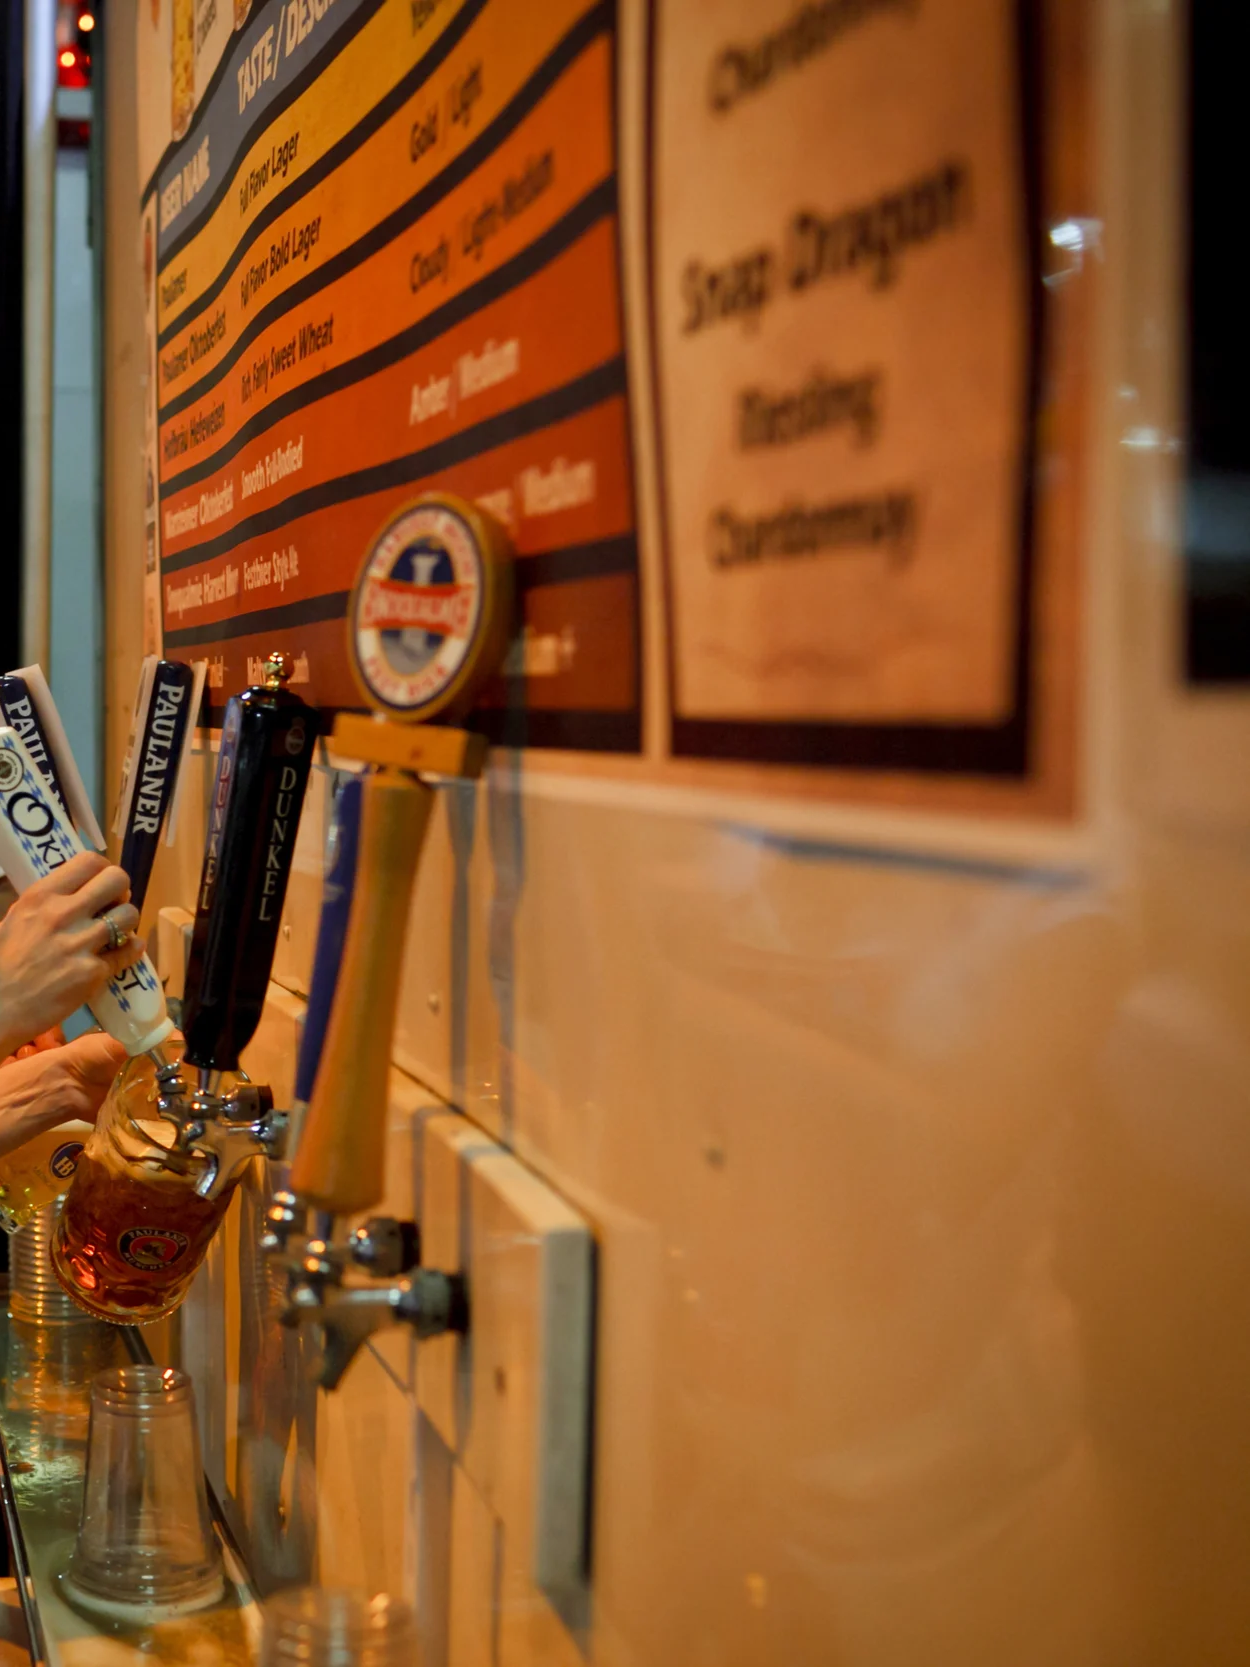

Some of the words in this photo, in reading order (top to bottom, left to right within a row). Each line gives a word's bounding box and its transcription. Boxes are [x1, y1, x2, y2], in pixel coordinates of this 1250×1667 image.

[237, 24, 274, 115] TASTE
[271, 131, 299, 178] Lager
[270, 231, 291, 278] Bold
[292, 215, 322, 262] Lager
[270, 336, 296, 380] Sweet
[299, 312, 334, 361] Wheat
[132, 681, 185, 834] PAULANER
[201, 756, 231, 909] DUNKEL
[258, 766, 297, 921] DUNKEL
